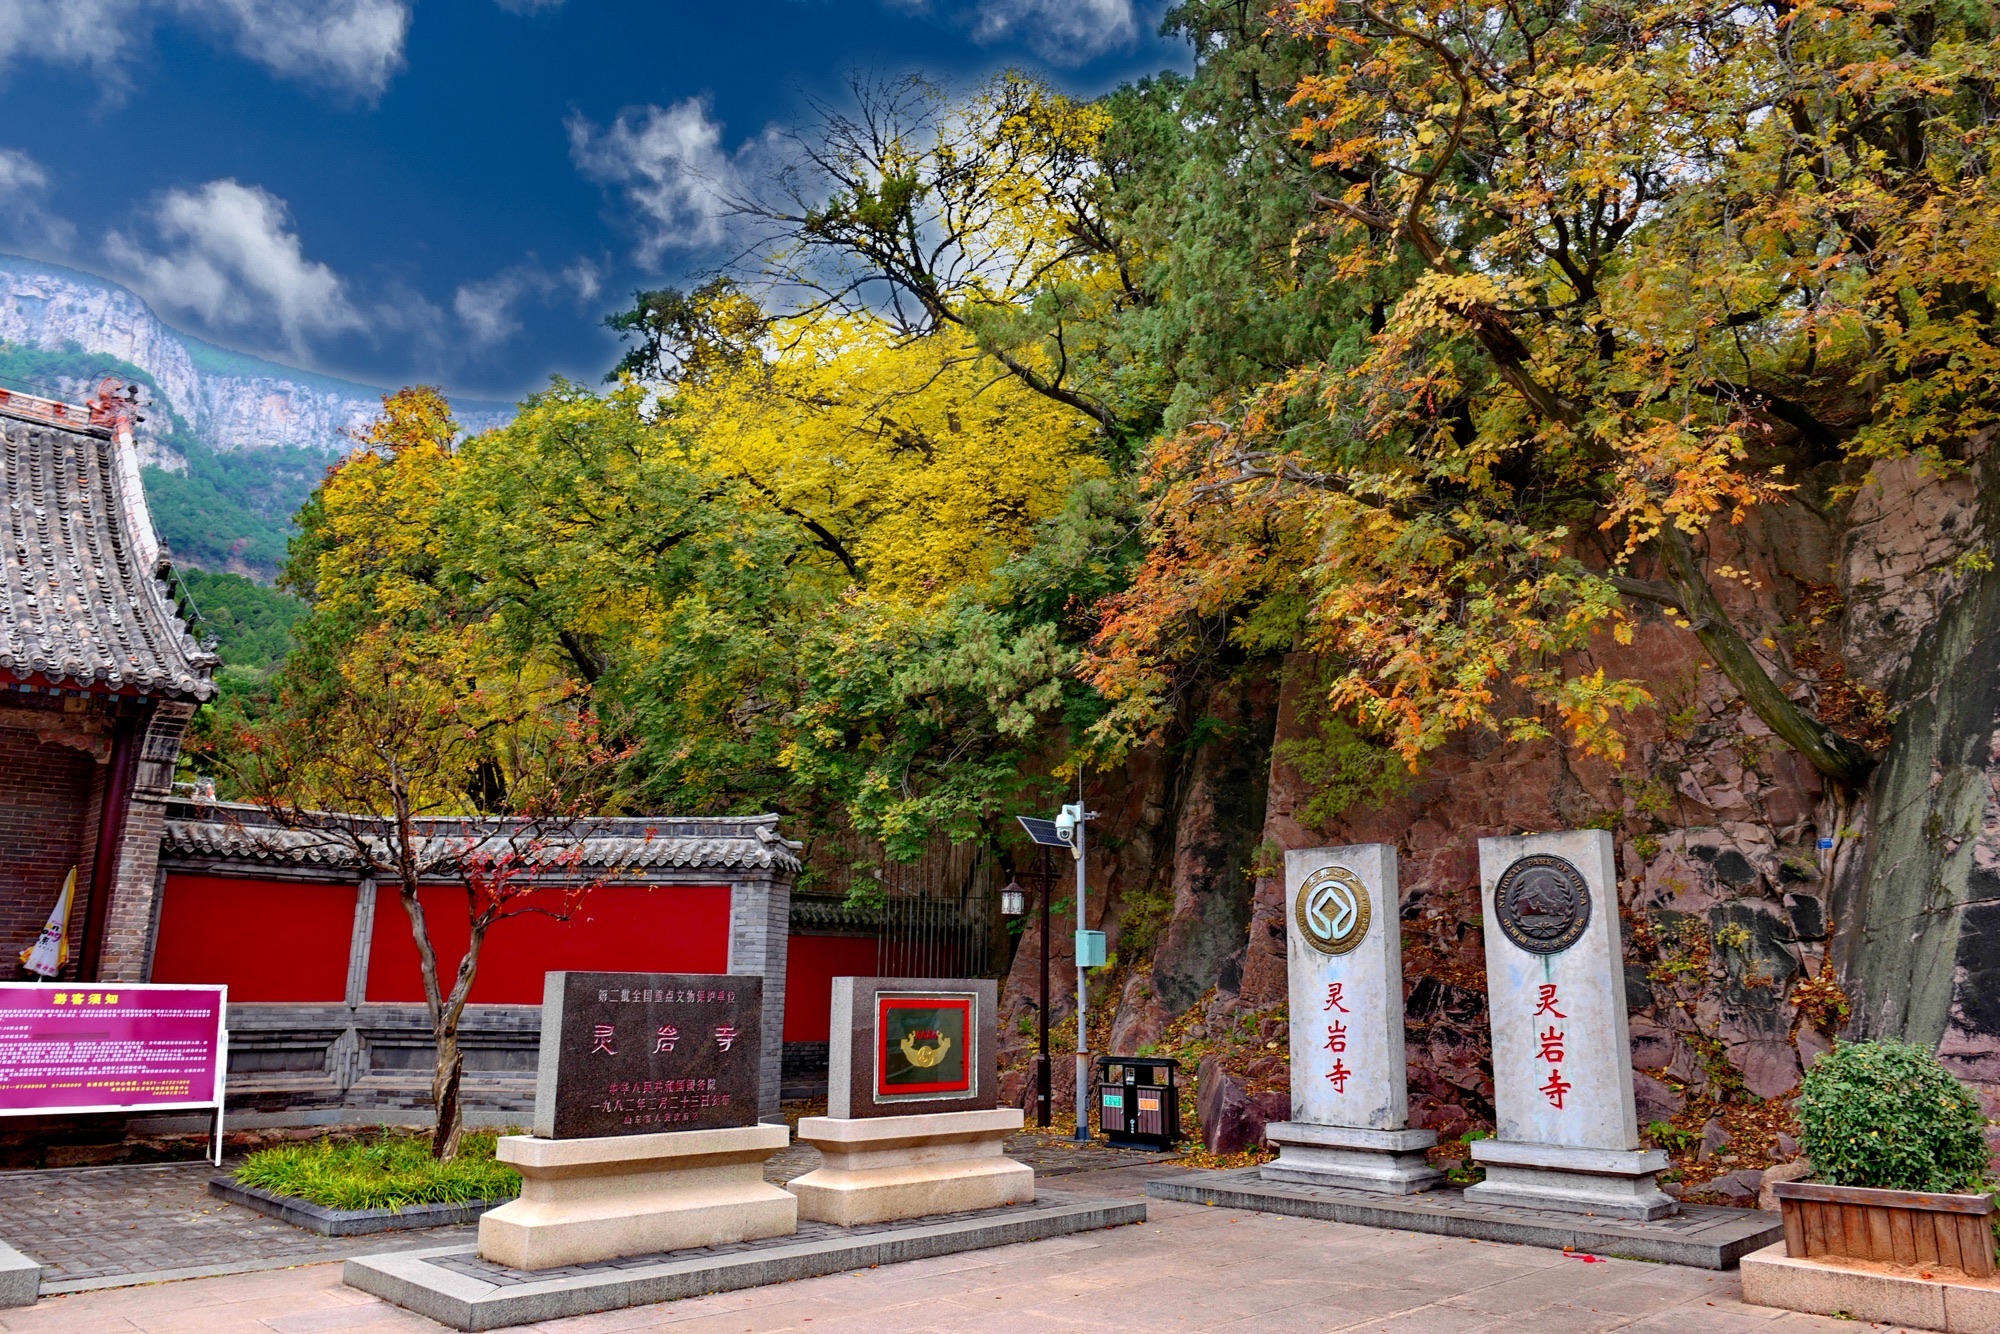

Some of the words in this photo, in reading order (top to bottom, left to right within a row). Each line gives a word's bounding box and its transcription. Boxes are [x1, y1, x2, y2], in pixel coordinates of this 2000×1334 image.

[1498, 864, 1523, 908] NATIONAL
[1527, 859, 1554, 867] PARK
[1557, 863, 1570, 874] OF
[1570, 873, 1587, 907] CHINA
[53, 992, 119, 1006] 游客须知
[598, 989, 736, 1004] 第二批全国重点文物保护单位
[591, 1024, 738, 1056] 灵岩寺
[1323, 982, 1352, 1095] 灵岩寺
[1532, 983, 1572, 1111] 灵岩寺
